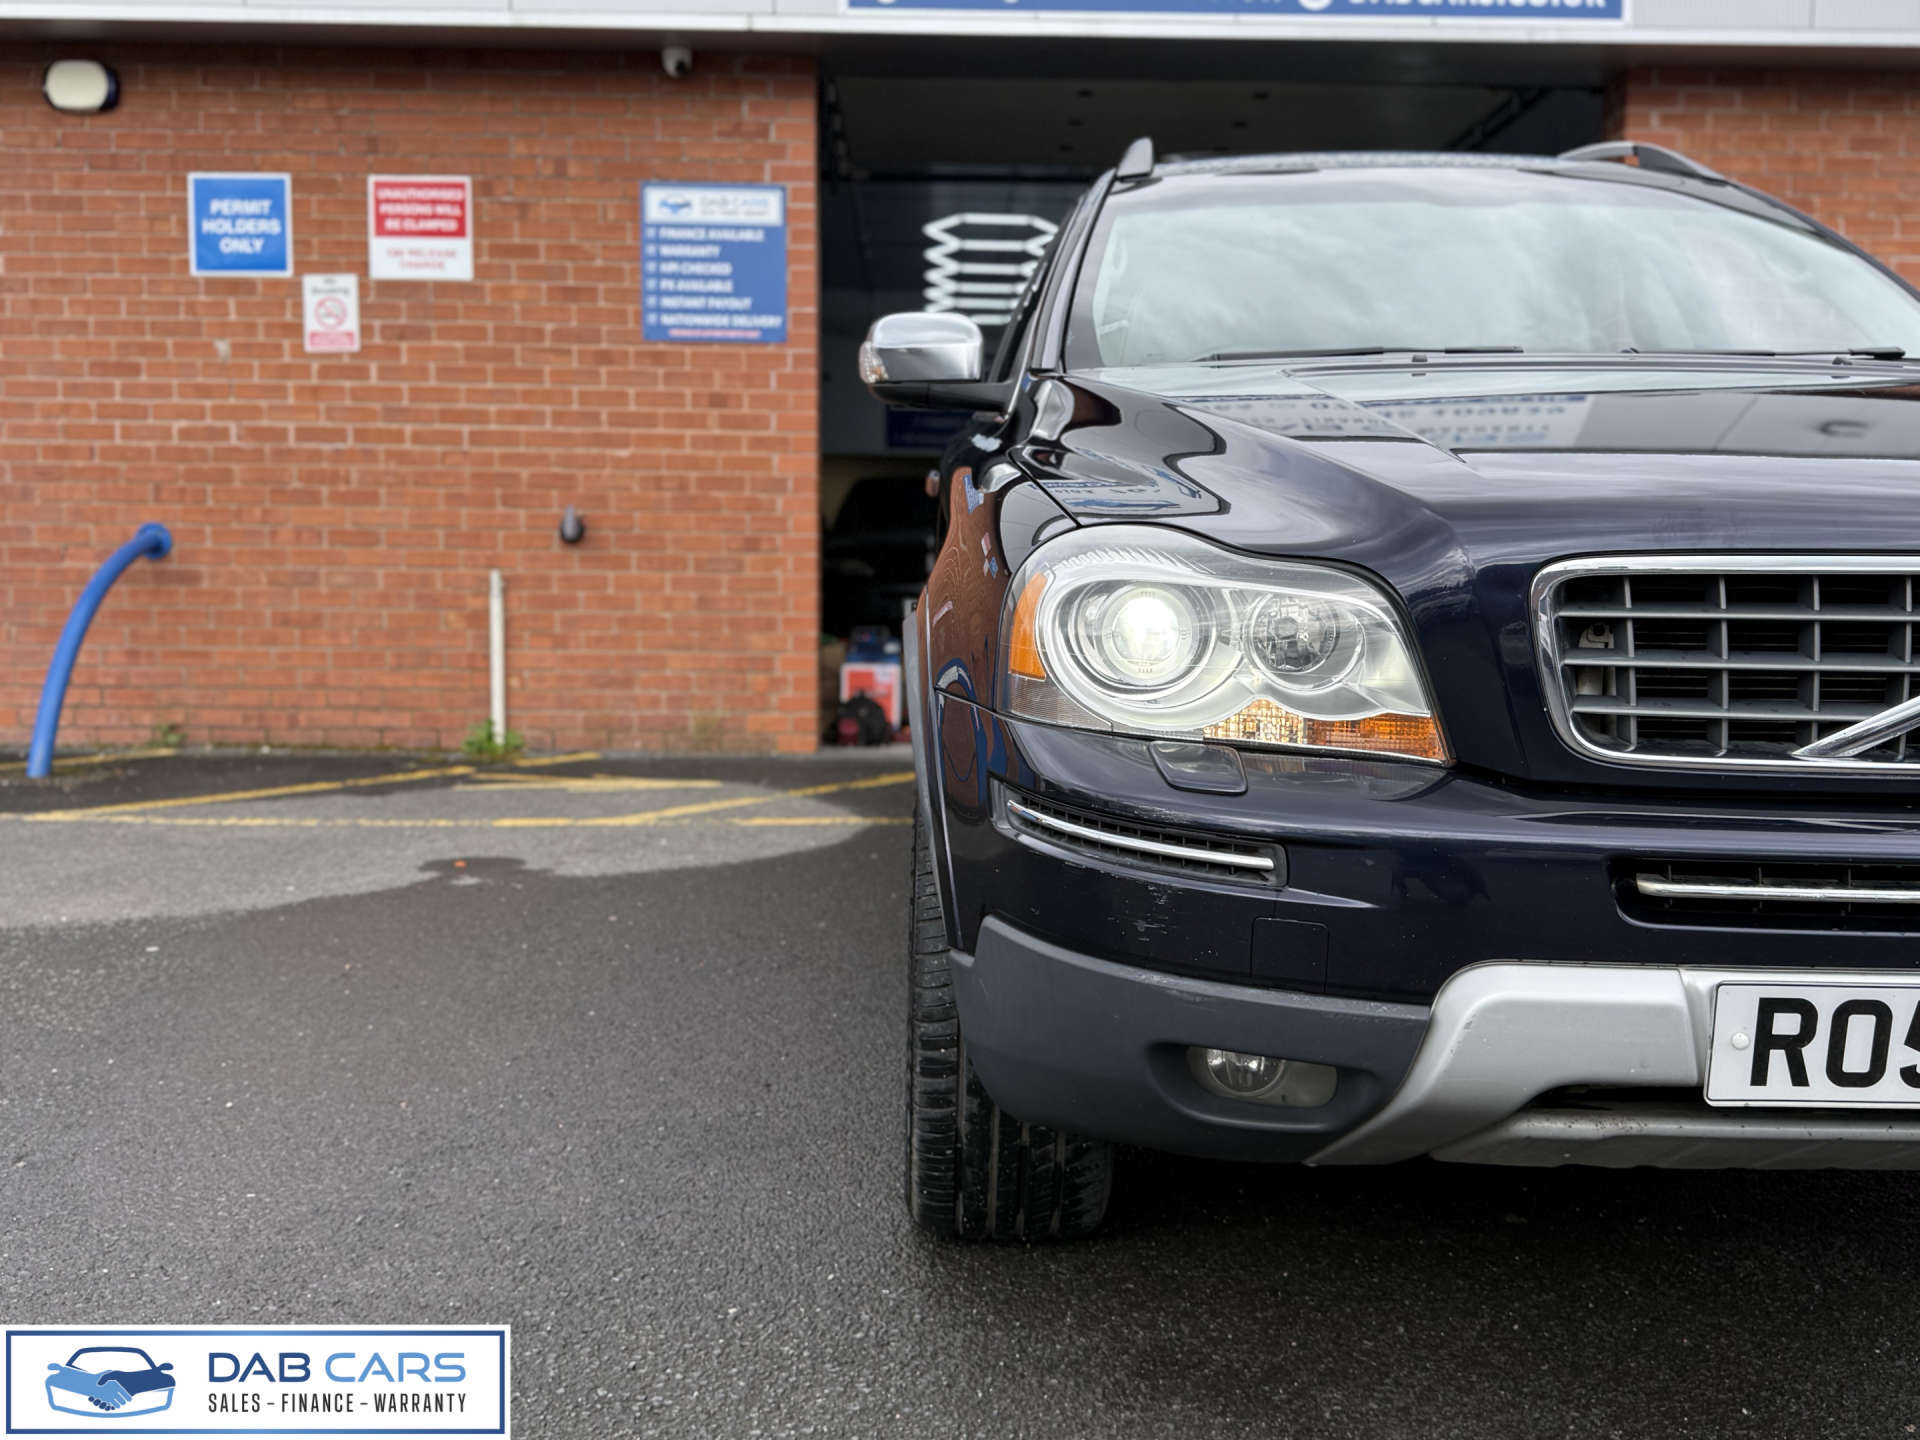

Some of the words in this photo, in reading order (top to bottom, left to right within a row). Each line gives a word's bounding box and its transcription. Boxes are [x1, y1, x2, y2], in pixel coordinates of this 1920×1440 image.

[210, 199, 273, 215] PERMIT
[379, 203, 432, 217] PERSONS
[434, 204, 463, 217] WILL
[202, 218, 281, 235] HOLDERS
[384, 218, 400, 231] BE
[401, 218, 459, 232] CLAMPED
[659, 227, 706, 240] FINANCE
[707, 229, 765, 242] AVAILABLE
[218, 237, 264, 254] ONLY
[659, 245, 721, 257] WARRANTY
[680, 262, 732, 275] CHECKED
[677, 280, 734, 293] AVAILABLE
[660, 296, 706, 309] INSTANT
[707, 297, 752, 310] PAYOUT
[660, 313, 730, 326] NATIONWIDE
[731, 315, 782, 328] DELIVERY
